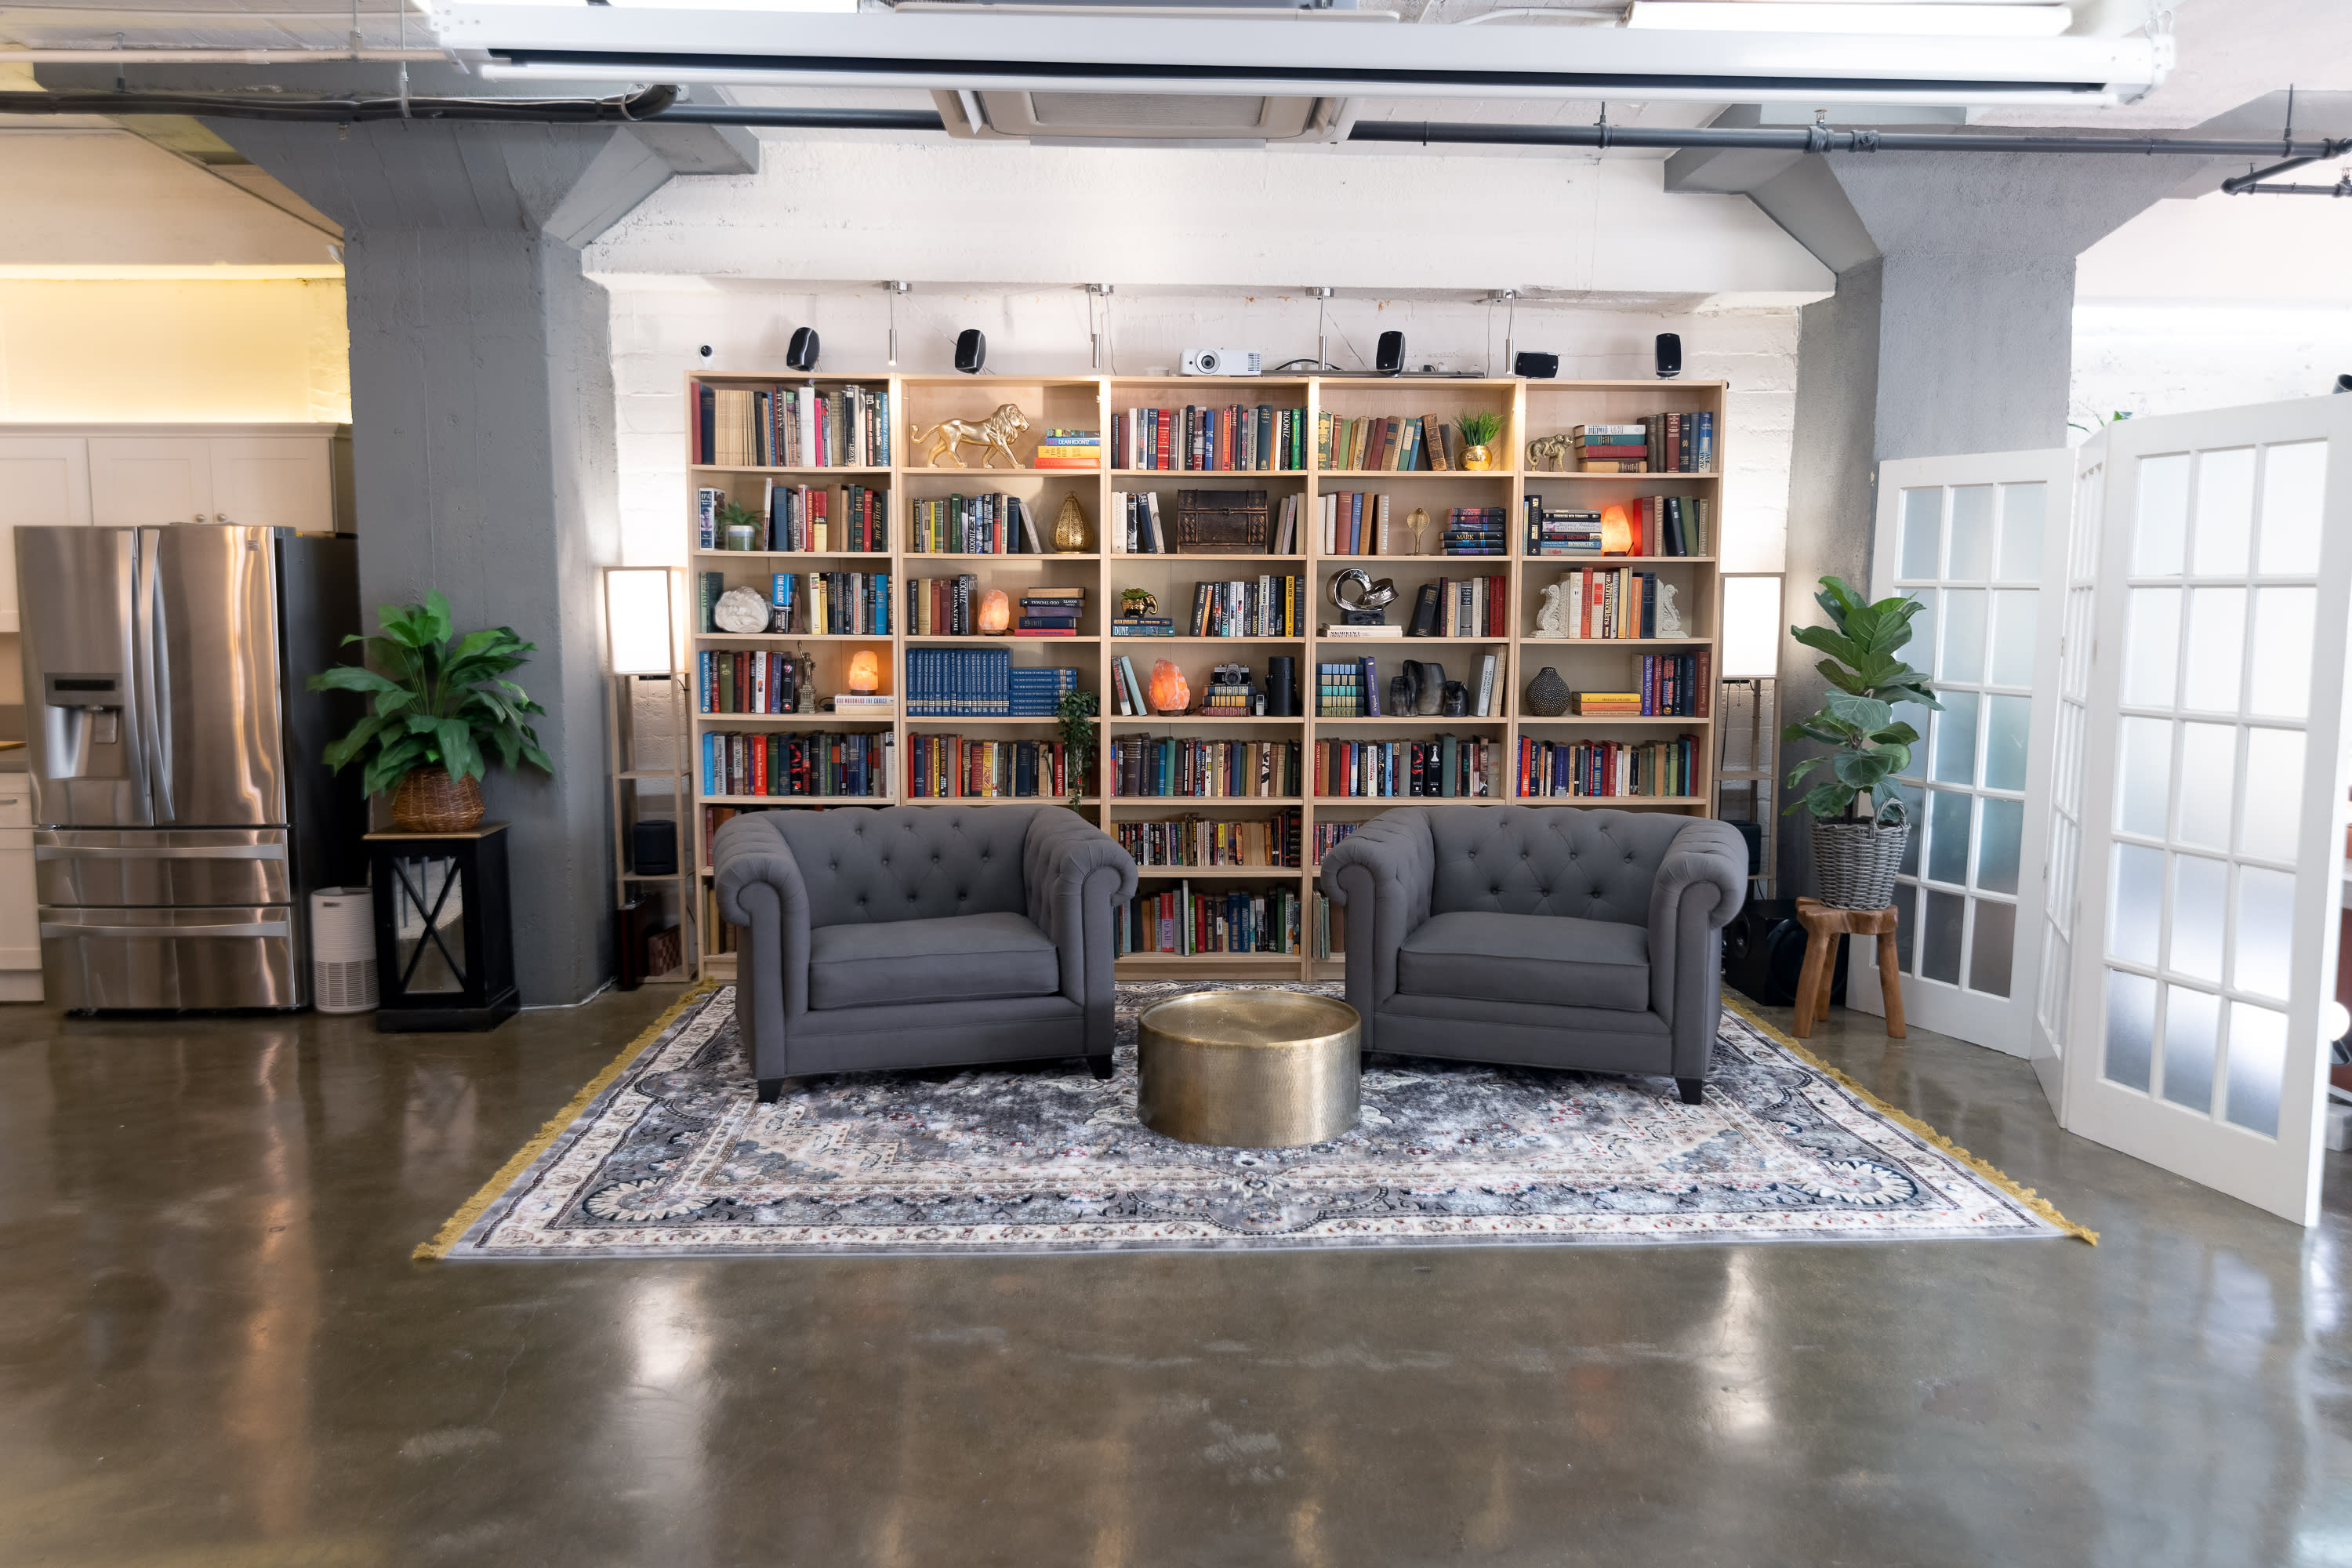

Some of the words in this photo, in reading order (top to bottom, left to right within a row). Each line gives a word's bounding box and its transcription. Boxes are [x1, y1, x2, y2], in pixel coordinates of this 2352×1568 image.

[875, 521, 881, 529] OF
[875, 529, 882, 540] ME
[1114, 626, 1129, 636] DUNE
